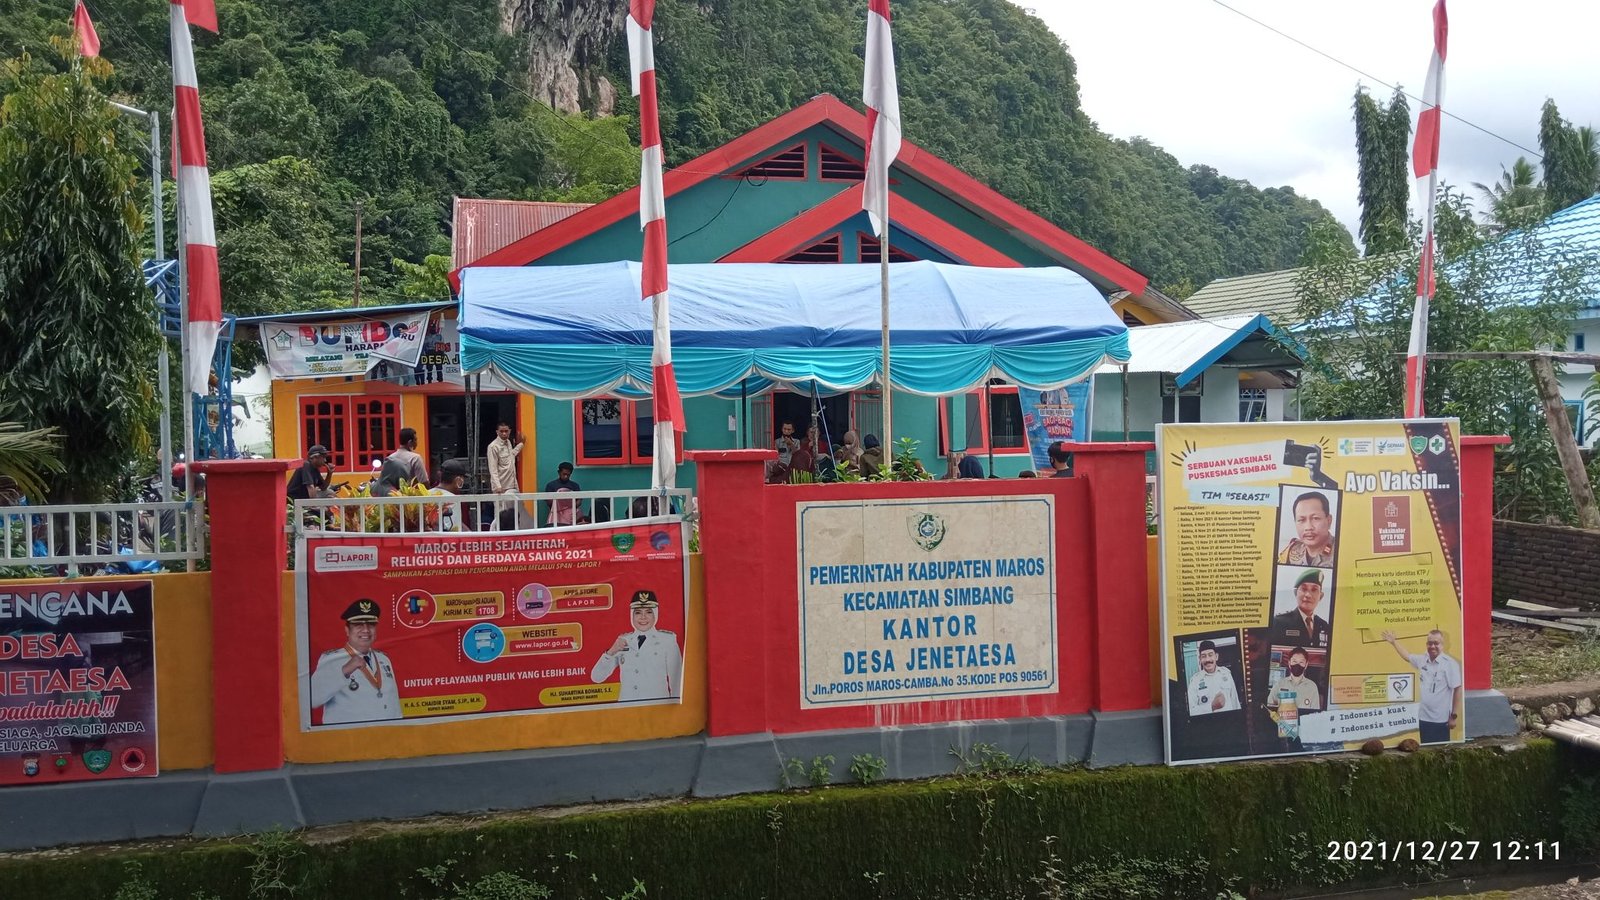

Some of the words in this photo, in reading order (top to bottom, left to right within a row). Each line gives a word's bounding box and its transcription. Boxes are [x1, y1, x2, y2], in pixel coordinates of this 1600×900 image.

[420, 354, 450, 365] DESA
[1187, 460, 1226, 470] SERBUAN
[1228, 454, 1272, 465] VAKSINASI
[1188, 469, 1239, 481] PUSKESMAS
[1240, 463, 1277, 474] SIMBANG
[1345, 471, 1377, 494] Ayo
[1380, 470, 1450, 491] Vaksin...
[1201, 491, 1221, 500] TIM
[1225, 491, 1270, 501] "SERASI"
[414, 543, 457, 554] MAROS
[459, 542, 492, 552] LEBIH
[495, 538, 569, 551] SEJAHTERAH,
[340, 553, 374, 562] LAPOR!
[391, 555, 444, 567] RELIGIUS
[447, 554, 472, 565] DAN
[474, 552, 526, 564] BERDAYA
[528, 551, 563, 562] SAING
[565, 549, 593, 560] 2021
[810, 562, 903, 585] PEMERINTAH
[908, 560, 992, 581] KABUPATEN
[996, 557, 1045, 577] MAROS
[843, 590, 940, 611] KECAMATAN
[944, 586, 1014, 607] SIMBANG
[478, 607, 495, 615] 1708
[522, 628, 558, 638] WEBSITE
[883, 615, 977, 640] KANTOR
[0, 632, 84, 660] DESA
[515, 639, 569, 650] www.lapor.go.id
[844, 650, 896, 675] DESA
[906, 643, 1016, 671] JENETAESA
[404, 678, 433, 687] UNTUK
[435, 675, 483, 685] PELAYANAN
[485, 672, 516, 682] PUBLIK
[517, 671, 540, 679] YANG
[541, 669, 565, 677] LEBIH
[566, 667, 586, 676] BAIK
[999, 672, 1018, 683] POS
[1020, 670, 1048, 682] 90561
[1338, 711, 1384, 721] Indonesia
[1386, 706, 1407, 716] kuat
[0, 727, 42, 739] SIAGA,
[44, 724, 80, 738] JAGA
[82, 724, 108, 736] DIRI
[108, 721, 146, 733] ANDA
[1340, 723, 1385, 734] Indonesia
[1388, 718, 1418, 728] tumbuh
